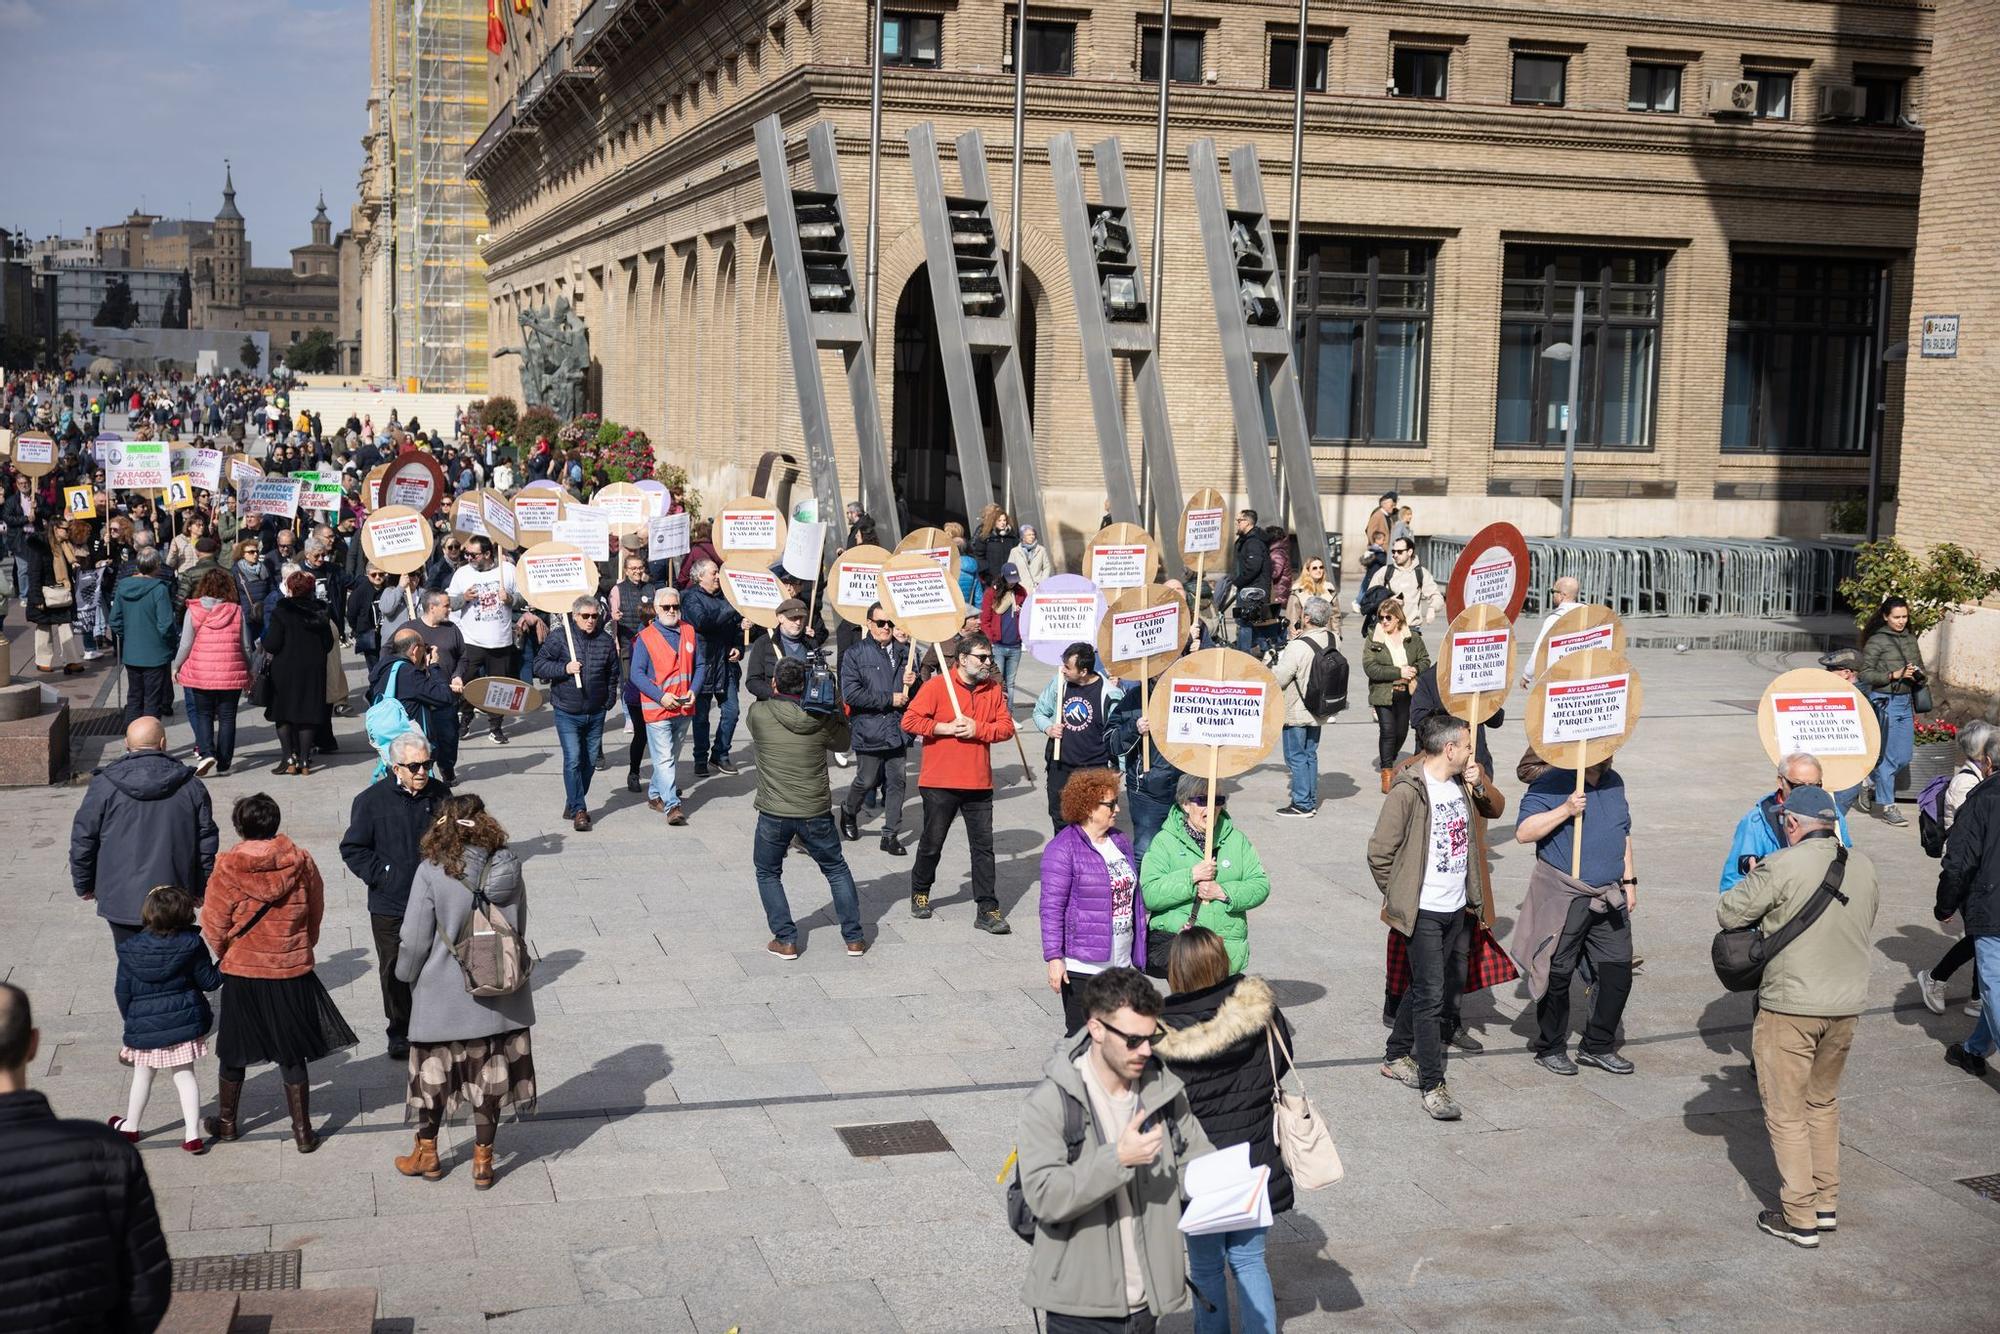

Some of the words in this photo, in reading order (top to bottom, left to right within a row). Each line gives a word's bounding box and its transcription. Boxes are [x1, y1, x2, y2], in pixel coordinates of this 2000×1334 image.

[1934, 323, 1956, 332] PLAZA
[198, 450, 218, 459] STOP
[255, 484, 294, 492] PARQUE
[1483, 570, 1502, 580] DEFENSA
[1487, 576, 1505, 586] SANIDAD
[1484, 591, 1504, 601] PRIVADA
[1125, 615, 1144, 623] PUERTA
[1156, 608, 1177, 618] CARMEN
[1133, 618, 1165, 630] CENTRO
[1141, 637, 1156, 646] YA!!
[1484, 644, 1503, 652] MEJORA
[1474, 653, 1485, 661] LAS
[1485, 652, 1500, 660] ZONAS
[1482, 660, 1505, 669] INCLUIDO
[1479, 669, 1493, 678] CANAL
[1586, 683, 1610, 692] BOZADA
[1562, 693, 1585, 703] parques
[1605, 689, 1626, 697] mueren
[1557, 696, 1617, 709] MANTENIMIENTO
[1173, 706, 1219, 716] RESIDUOS
[1221, 708, 1260, 717] ANTIGUA
[1552, 708, 1593, 718] ADECUADO
[1594, 707, 1603, 715] DE
[1605, 704, 1620, 713] LOS
[1196, 716, 1235, 726] QUÍMICA
[1558, 716, 1594, 726] PARQUES
[1598, 714, 1612, 722] YA!!
